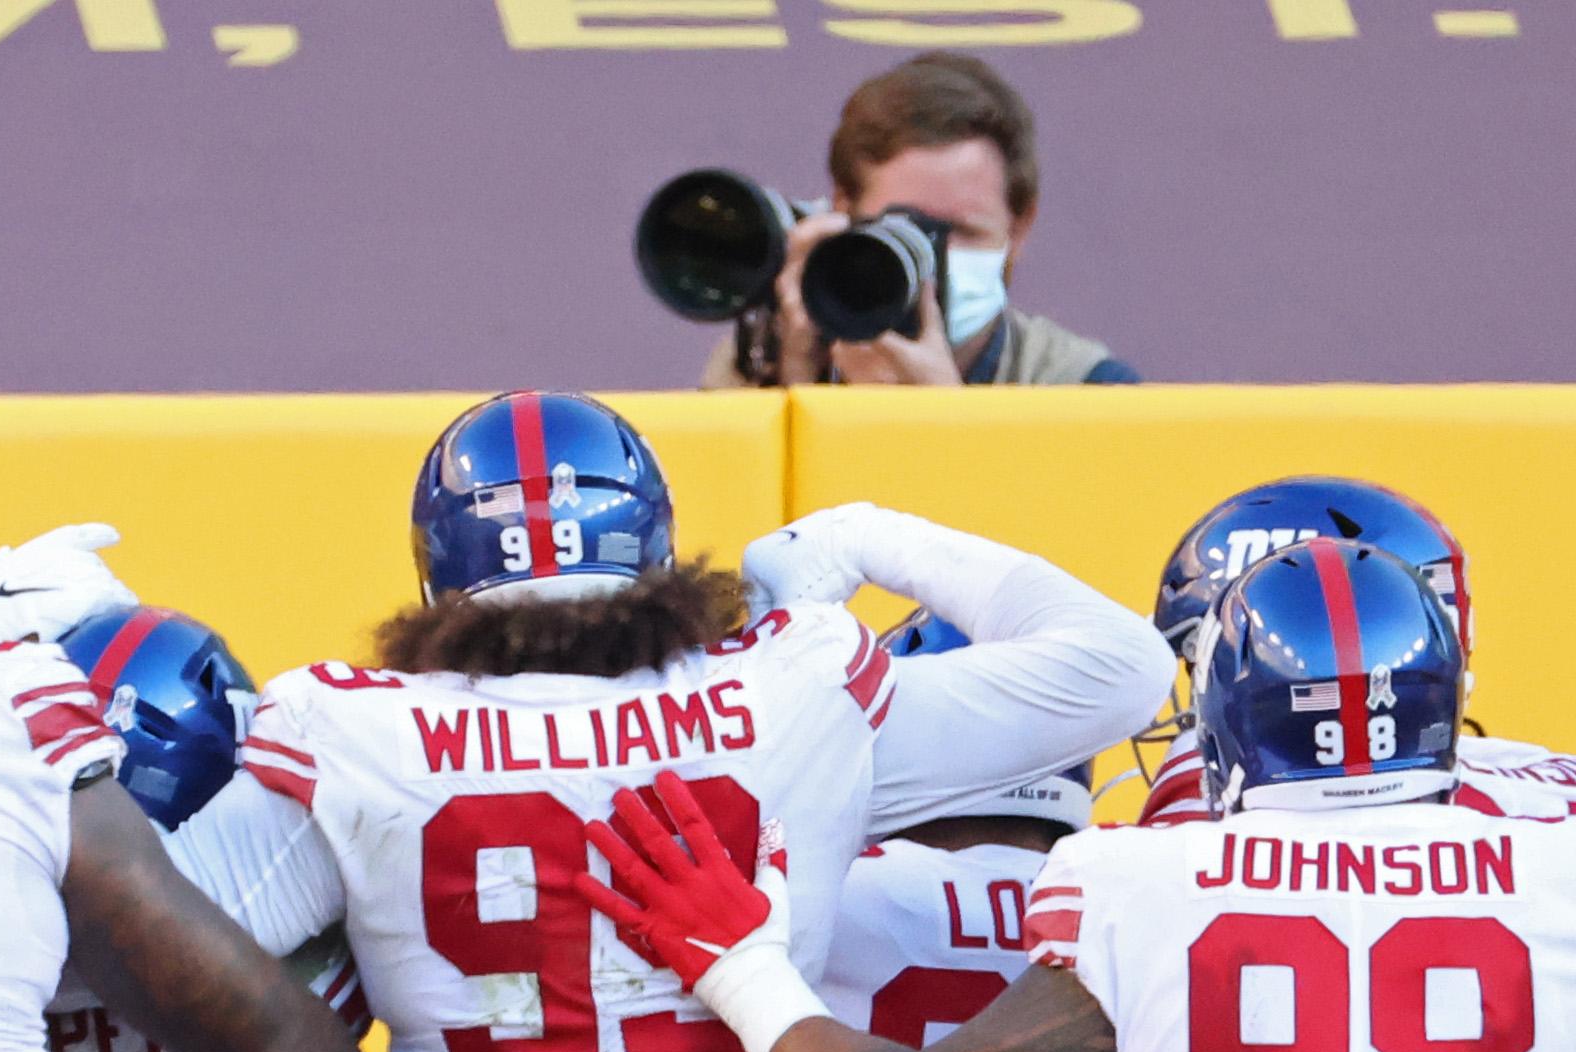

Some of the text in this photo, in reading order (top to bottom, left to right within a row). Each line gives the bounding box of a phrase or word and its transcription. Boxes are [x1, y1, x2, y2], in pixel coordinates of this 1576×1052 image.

[499, 518, 585, 573] 99
[411, 679, 757, 774] WILLIAMS
[1314, 714, 1397, 766] 98
[1195, 834, 1516, 896] JOHNSON
[942, 879, 1030, 951] LO
